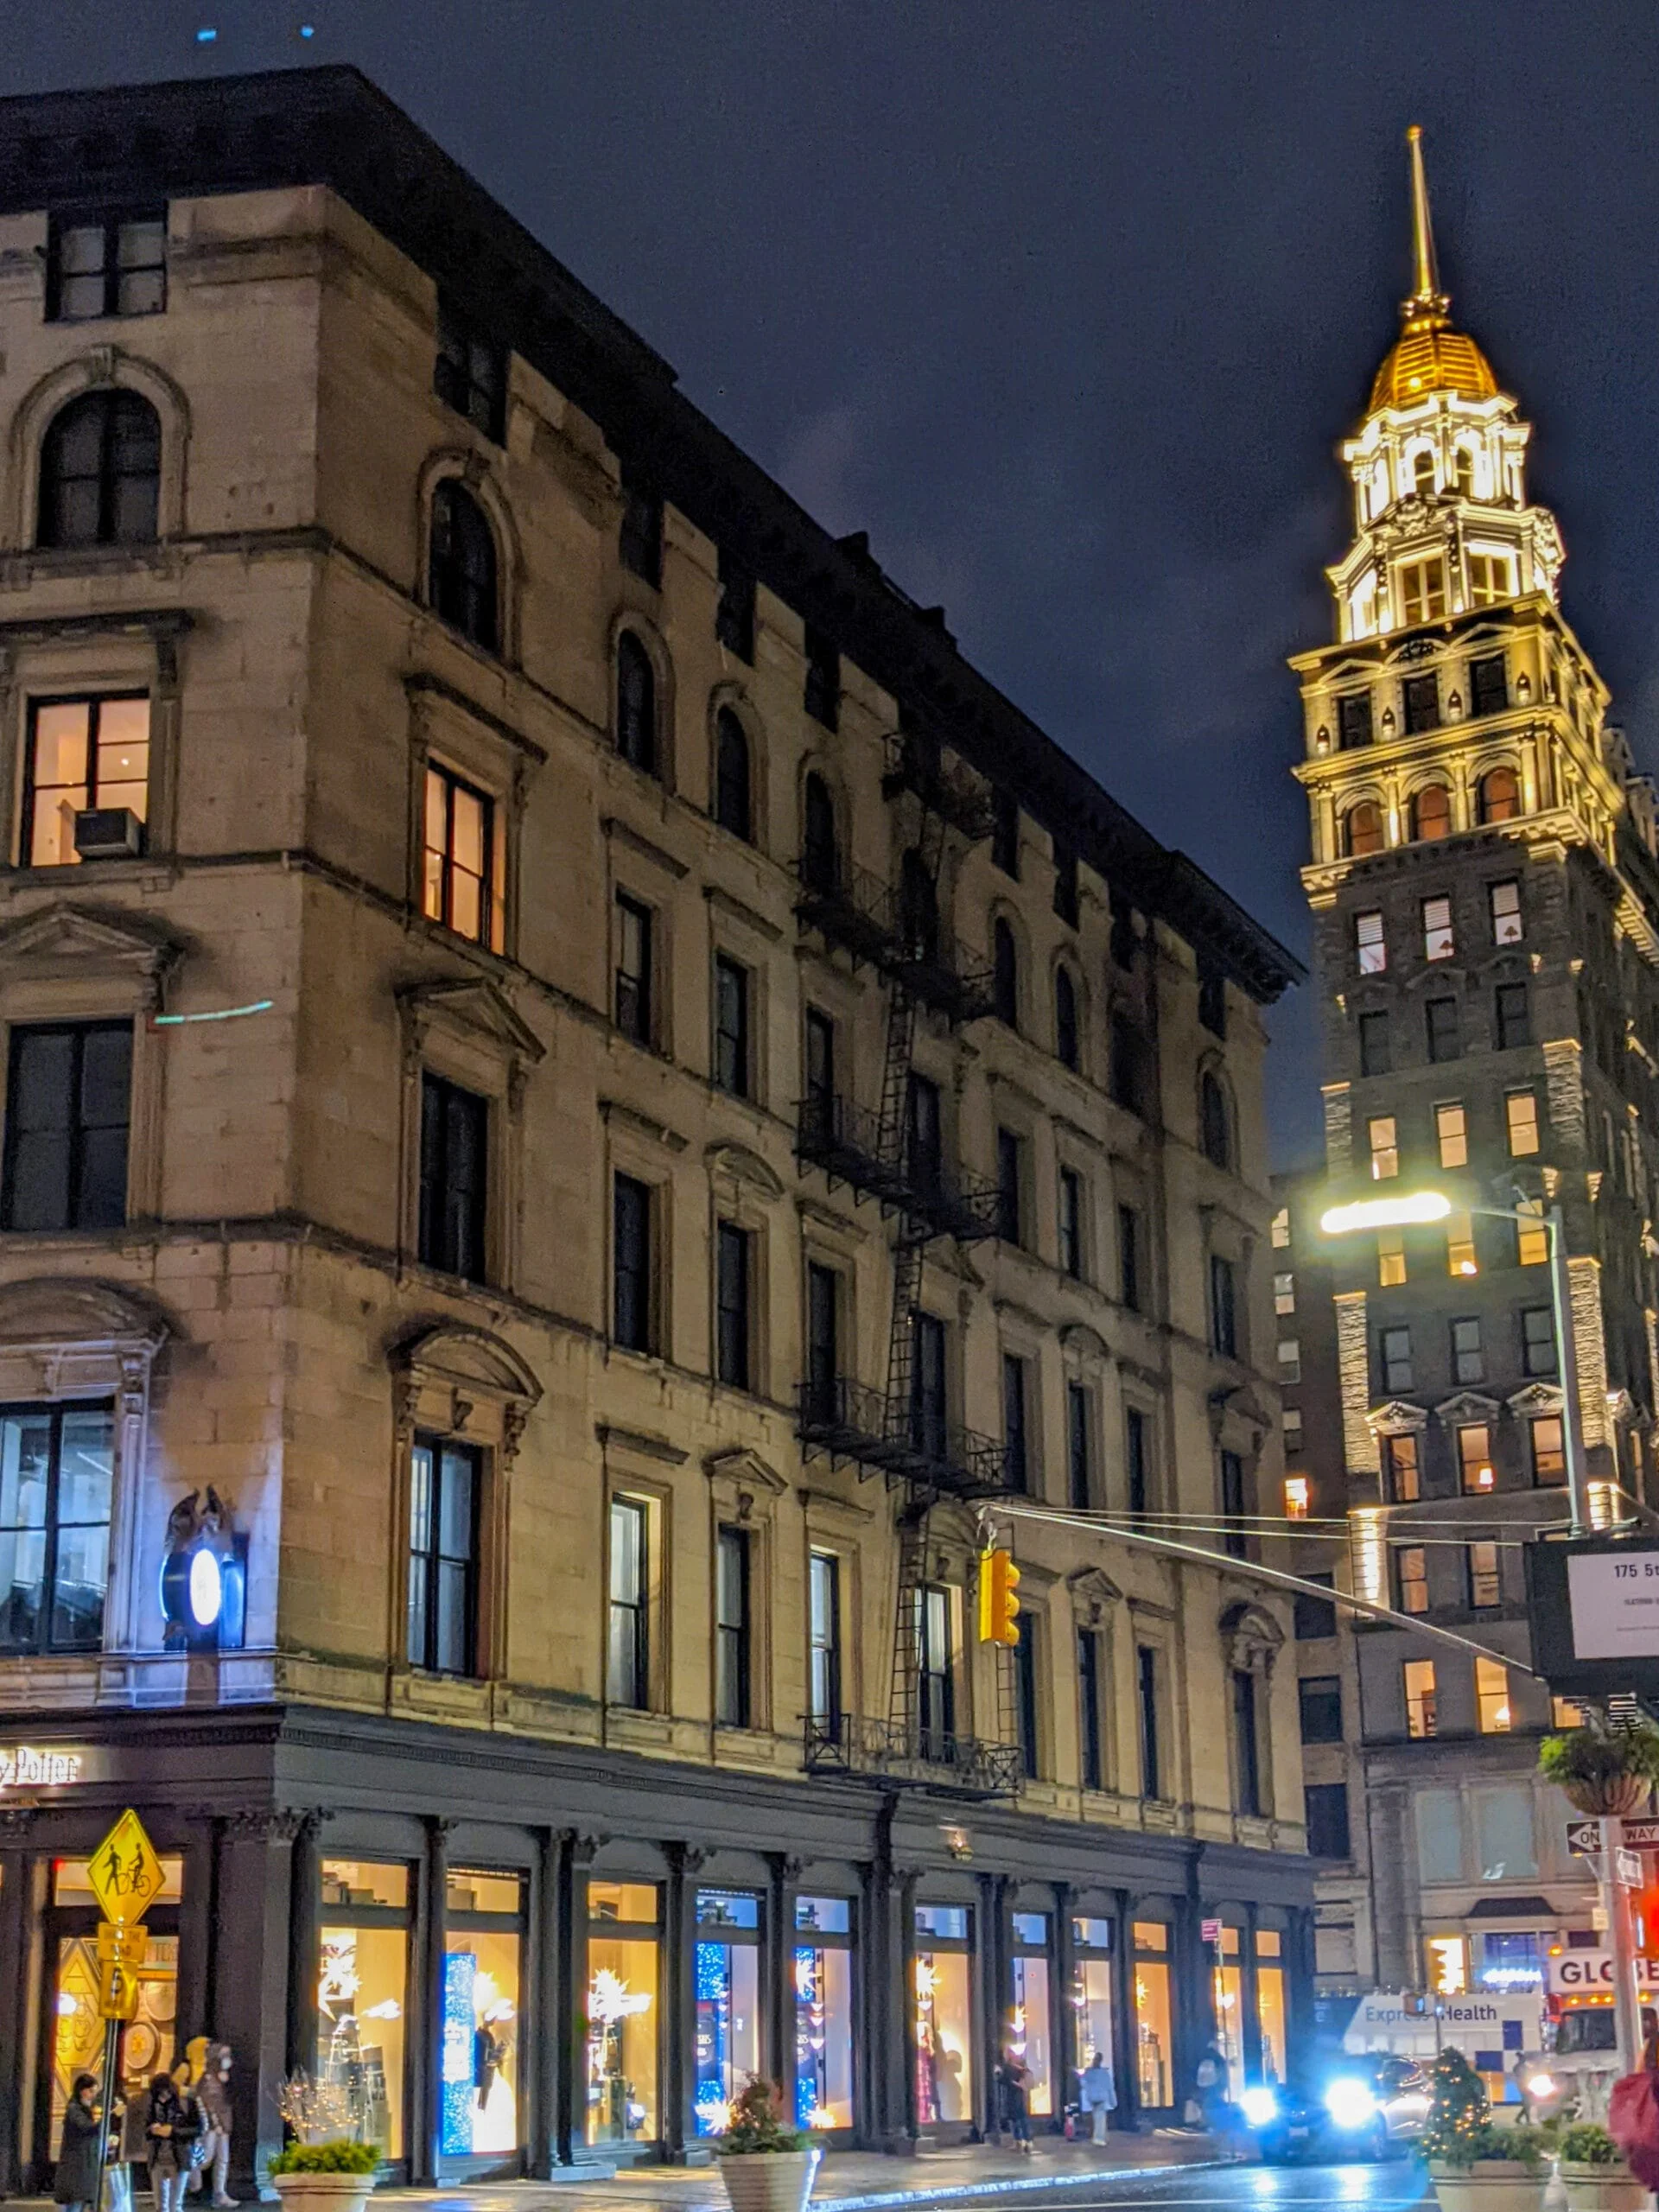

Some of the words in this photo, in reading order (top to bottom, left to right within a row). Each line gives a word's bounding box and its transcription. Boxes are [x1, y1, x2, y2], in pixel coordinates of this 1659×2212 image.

[1614, 1565, 1637, 1578] 175
[15, 1748, 78, 1783] Potter
[1580, 1831, 1600, 1844] ON
[1624, 1827, 1656, 1840] WAY
[1441, 2005, 1497, 2021] Health
